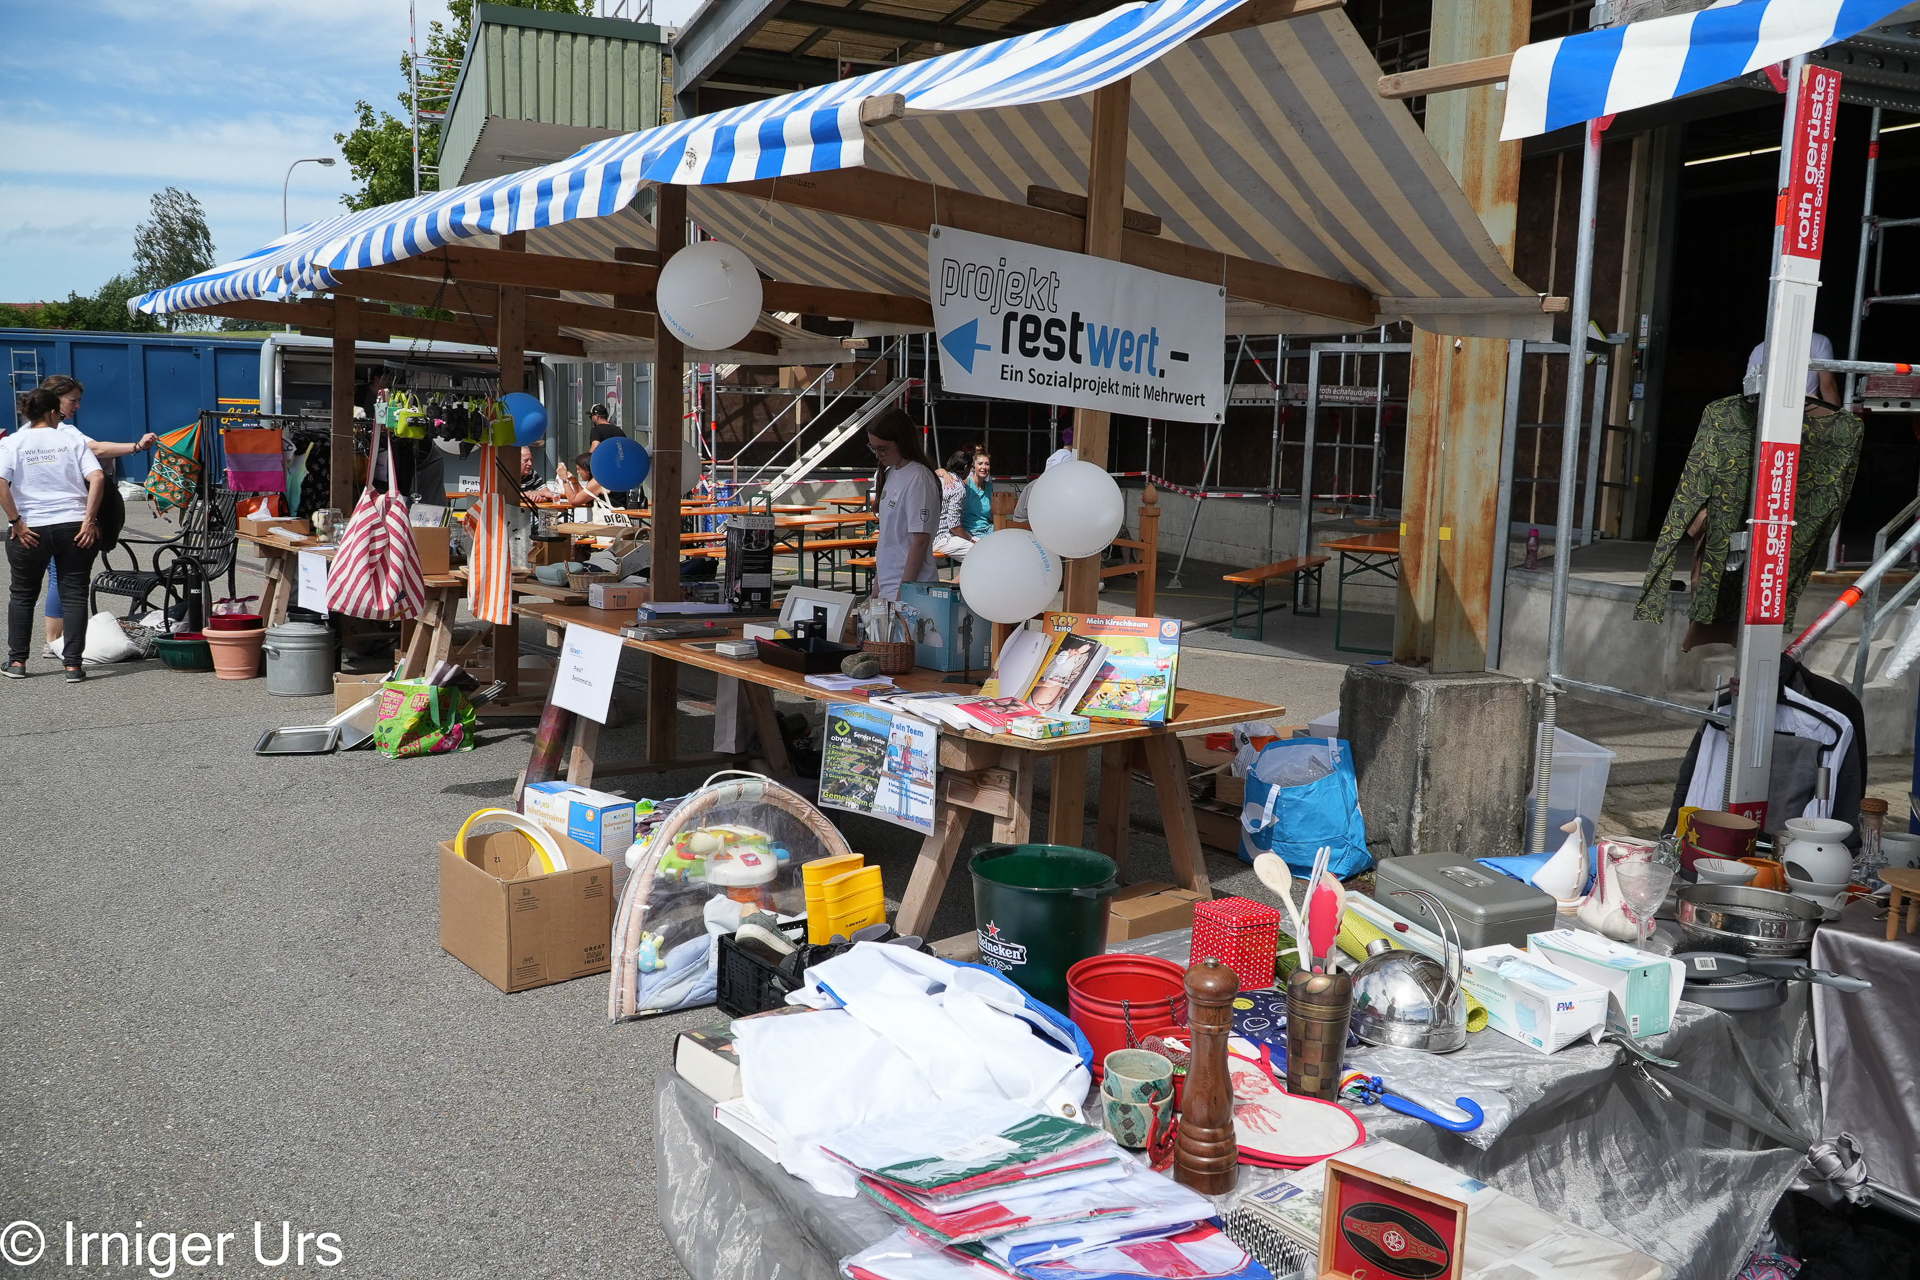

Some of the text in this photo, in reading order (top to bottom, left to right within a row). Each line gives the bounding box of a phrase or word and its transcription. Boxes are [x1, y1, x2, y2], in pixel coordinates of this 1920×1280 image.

[1797, 73, 1827, 250] roth gerüste
[1811, 77, 1836, 251] wenn Schönes entsteht
[940, 257, 1060, 315] projekt
[1000, 364, 1206, 407] Ein Sozialprojekt mit Mehrwert
[1332, 388, 1378, 398] échafaudages
[1760, 449, 1785, 618] roth gerüste
[1773, 451, 1795, 618] wenn Schönes entsteht
[1050, 615, 1079, 627] TOY
[1086, 617, 1149, 628] Mein Kirschbaum
[843, 708, 865, 719] Zwei
[907, 725, 924, 737] Team
[831, 735, 852, 743] obvita
[400, 745, 420, 754] ON
[526, 805, 566, 824] Toilettentrainer
[823, 791, 868, 807] Gemeinsam
[869, 802, 888, 812] durch
[915, 815, 931, 828] Dünn
[584, 943, 606, 953] GREAT
[584, 956, 606, 965] INSIDE
[1260, 1184, 1292, 1200] meradiso
